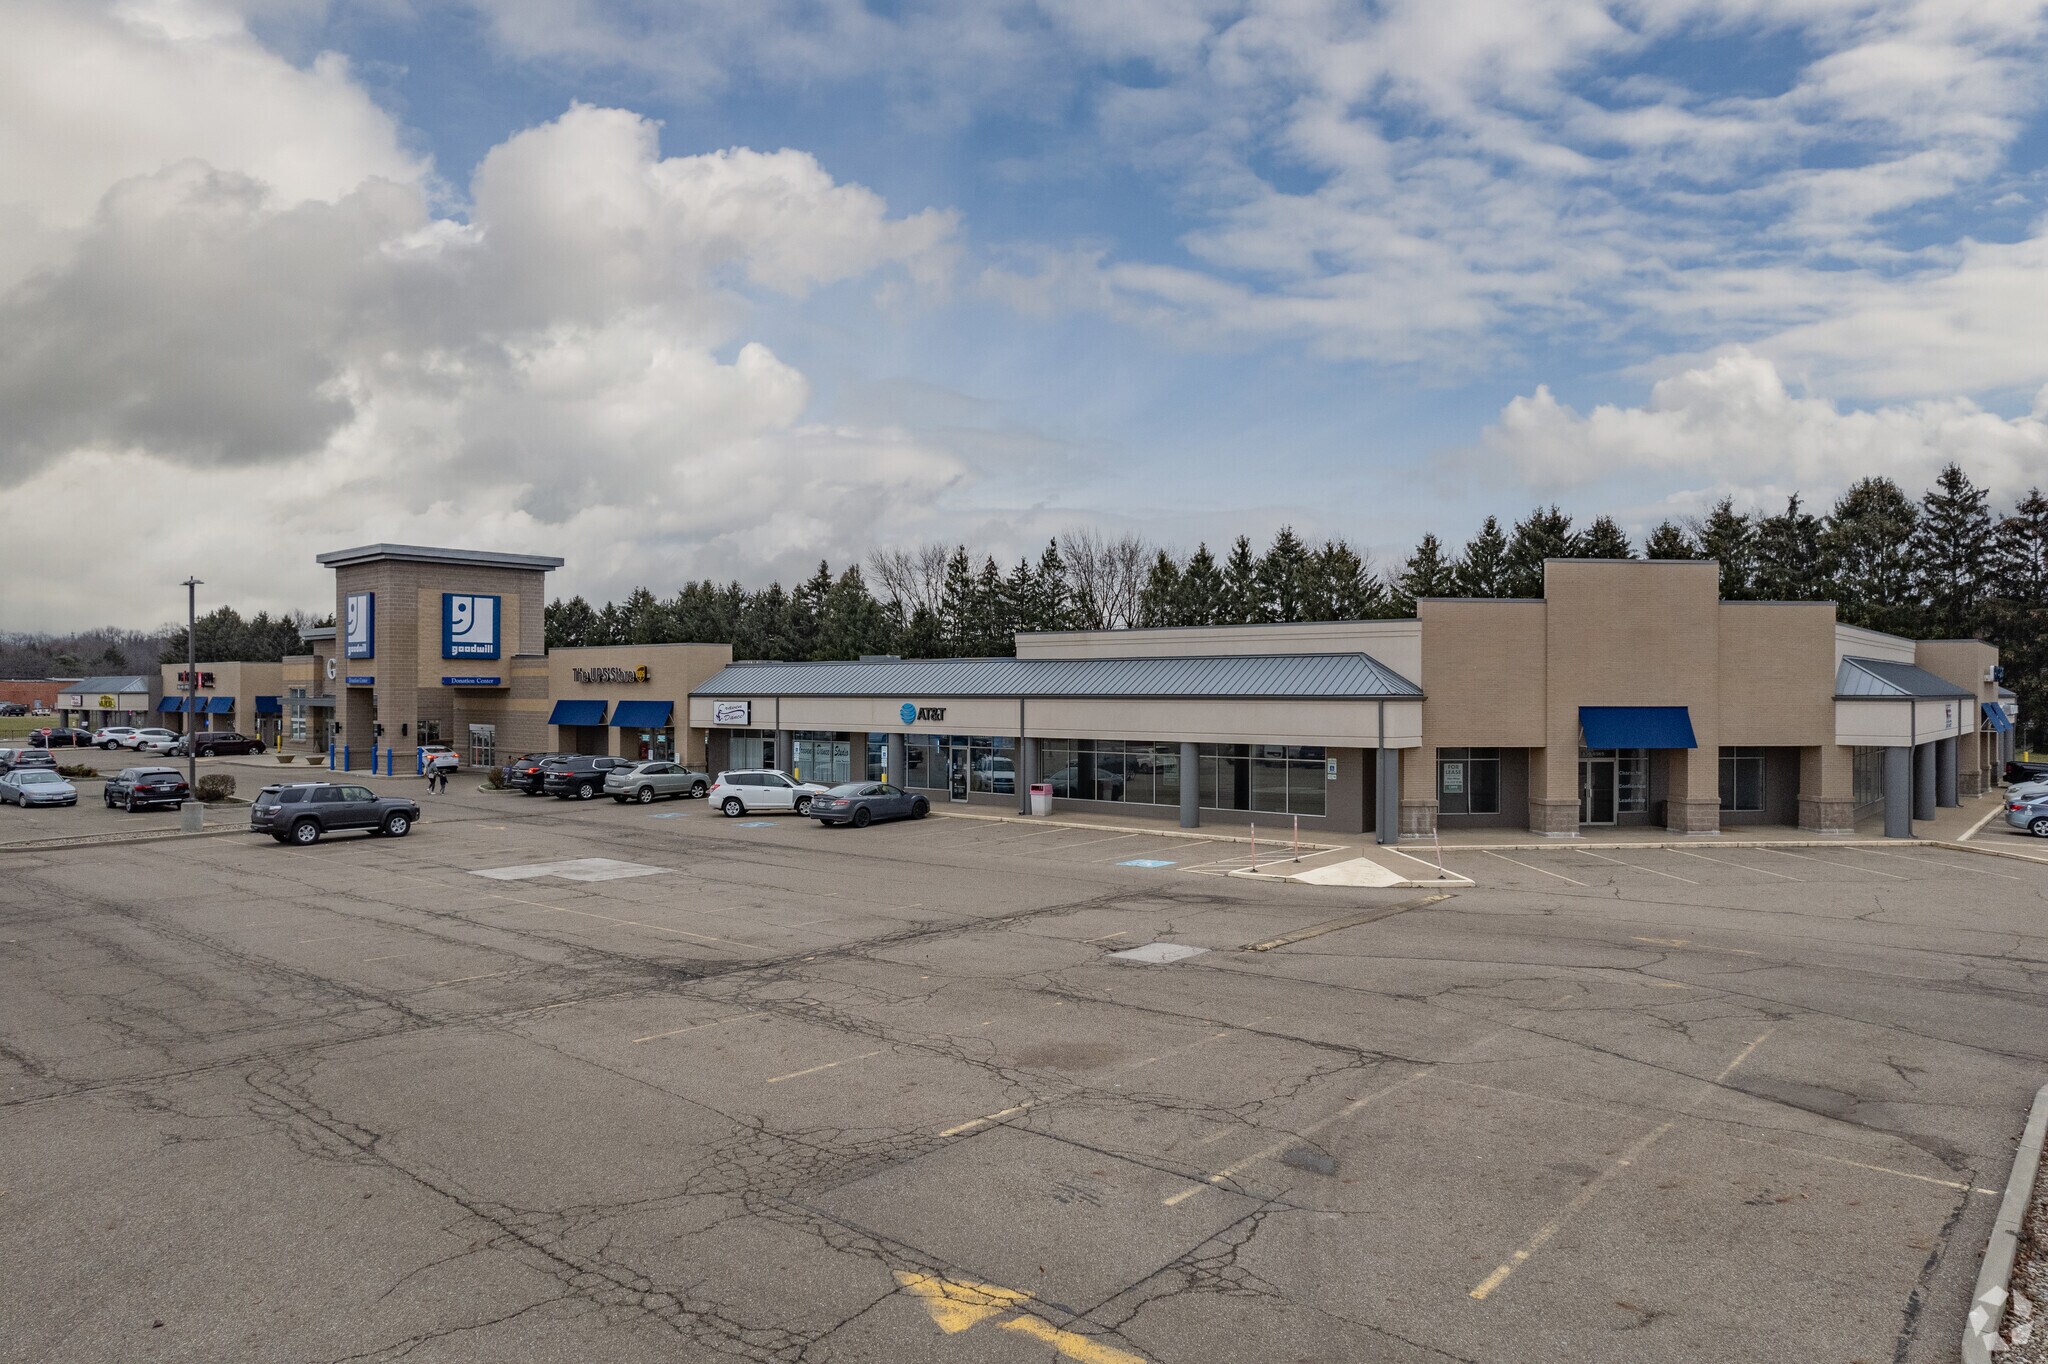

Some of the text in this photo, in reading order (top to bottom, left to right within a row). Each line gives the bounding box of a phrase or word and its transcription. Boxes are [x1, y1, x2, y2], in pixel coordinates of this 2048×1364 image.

[451, 644, 494, 656] goodwill
[572, 667, 590, 682] The
[610, 667, 636, 682] Store
[718, 703, 742, 711] Craven
[917, 707, 947, 721] AT&T
